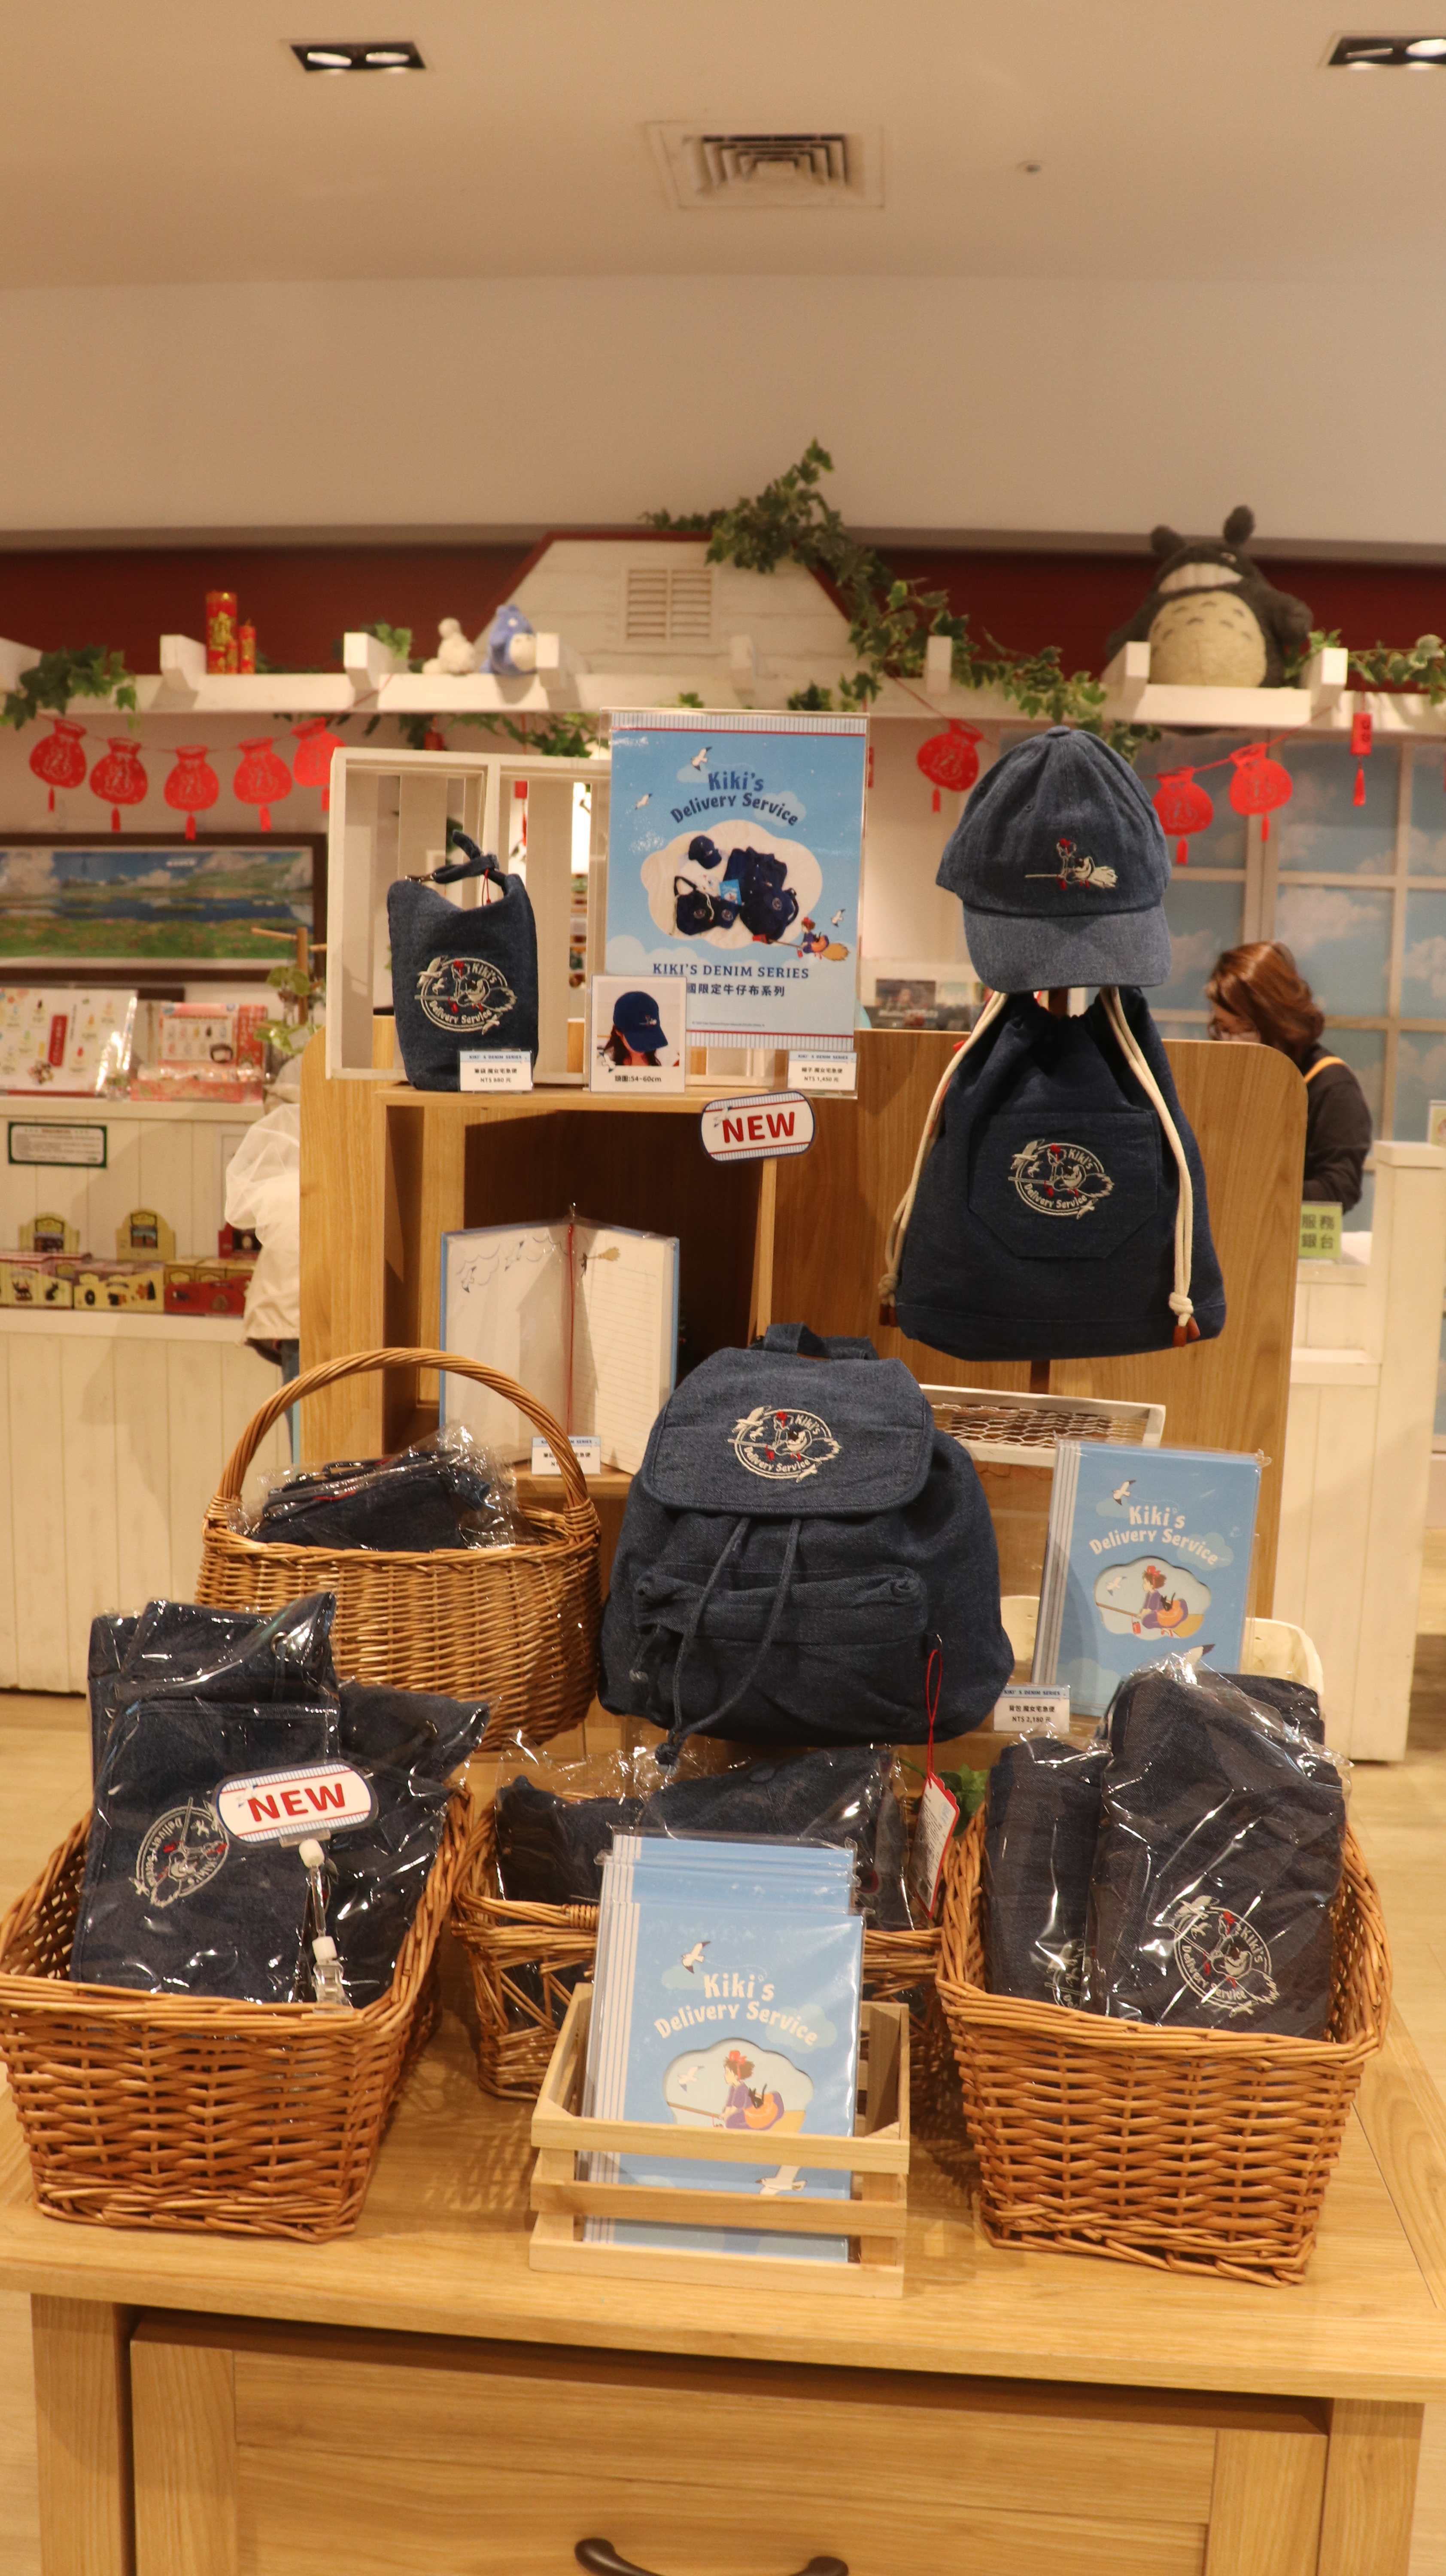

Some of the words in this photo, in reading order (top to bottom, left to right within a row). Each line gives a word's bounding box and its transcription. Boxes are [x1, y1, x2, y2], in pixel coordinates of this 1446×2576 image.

[708, 771, 764, 791] Kiki's
[670, 795, 736, 823] Delivery
[742, 792, 798, 826] Service
[653, 963, 697, 975] KIKI'S
[703, 965, 752, 976] DENIM
[758, 967, 809, 978] SERIES
[722, 1112, 795, 1143] NEW
[1089, 1529, 1157, 1555] Delivery
[1162, 1528, 1218, 1565] Service
[247, 1783, 346, 1823] NEW
[654, 2003, 740, 2038] Delivery
[746, 2001, 818, 2047] Service
